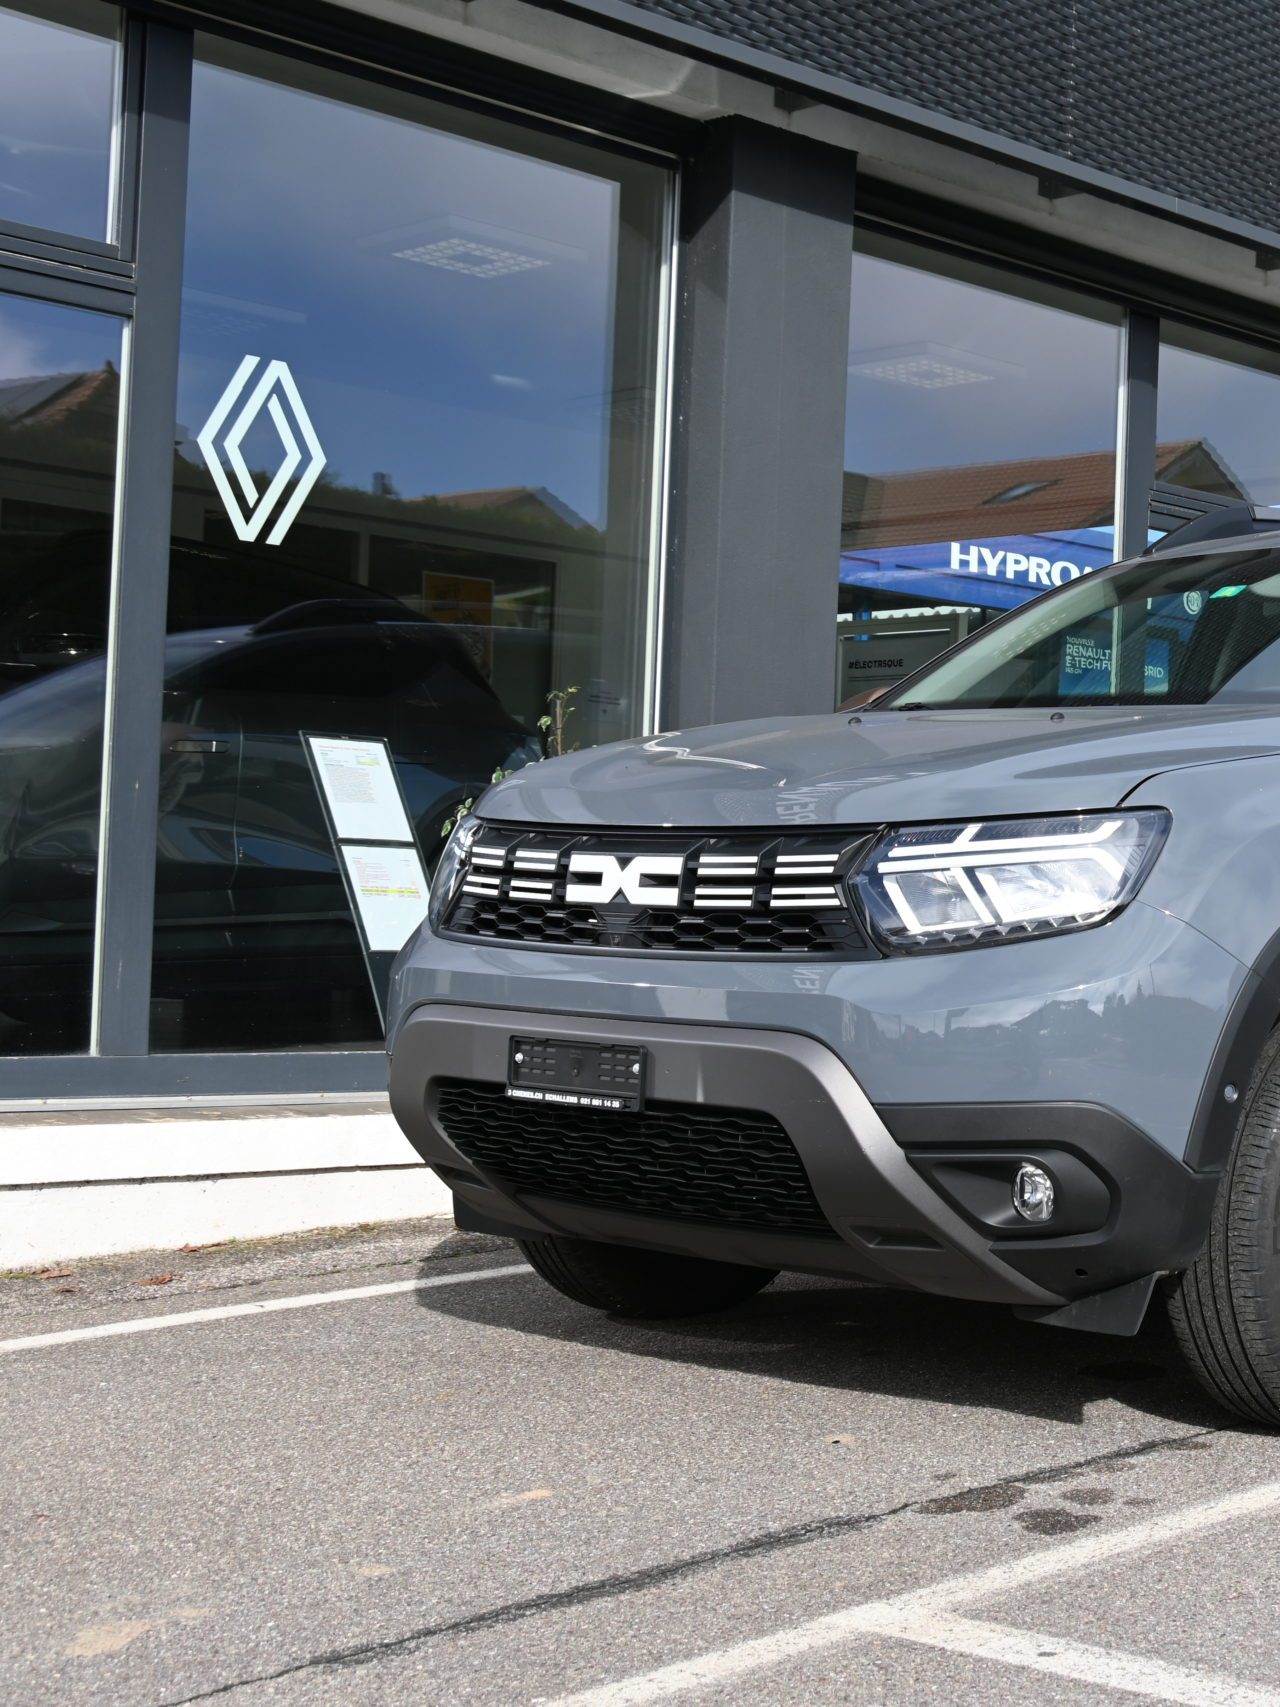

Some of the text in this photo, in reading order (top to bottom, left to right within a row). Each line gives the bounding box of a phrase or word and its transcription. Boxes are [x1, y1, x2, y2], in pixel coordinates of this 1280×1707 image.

[950, 542, 1094, 587] HYPRO
[1066, 644, 1111, 660] RENAULT
[1065, 656, 1101, 670] E-TECH
